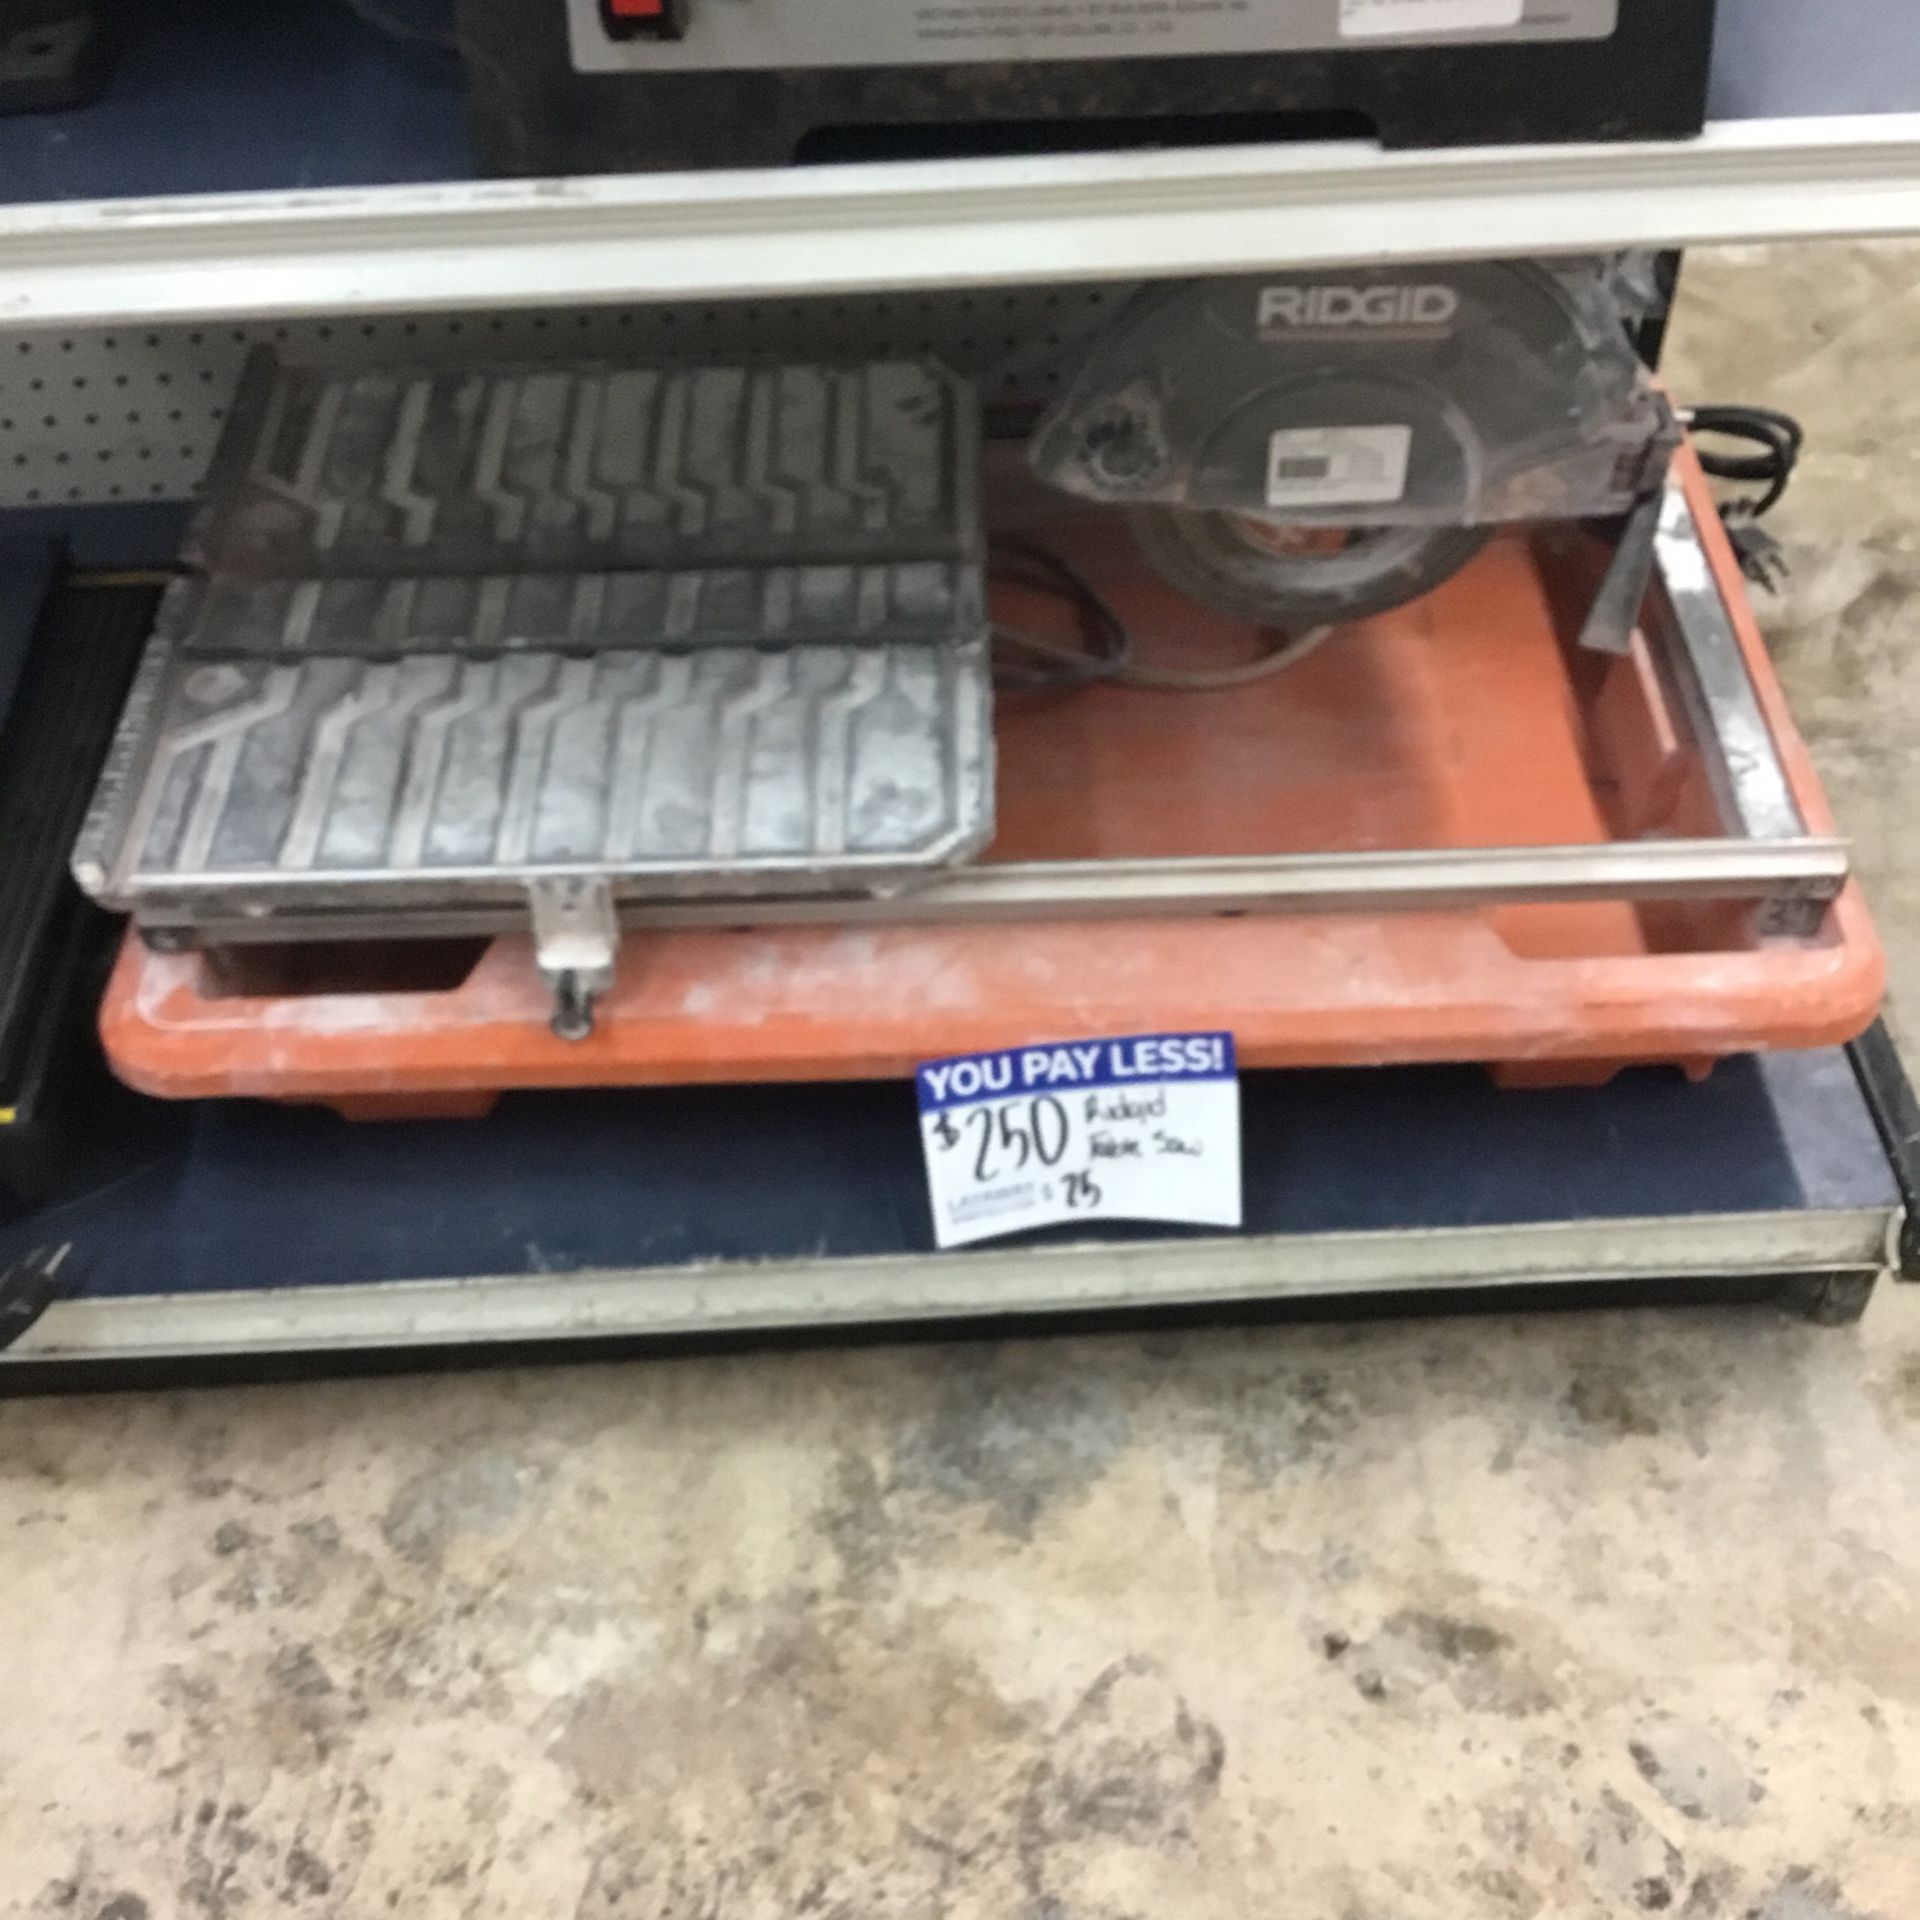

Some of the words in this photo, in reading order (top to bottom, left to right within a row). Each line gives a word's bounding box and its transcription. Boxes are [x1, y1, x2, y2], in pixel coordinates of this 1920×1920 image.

[1258, 284, 1458, 325] RIDGID
[924, 1055, 1012, 1100] YOU
[1022, 1045, 1100, 1085] PAY
[1110, 1037, 1224, 1077] LESS!
